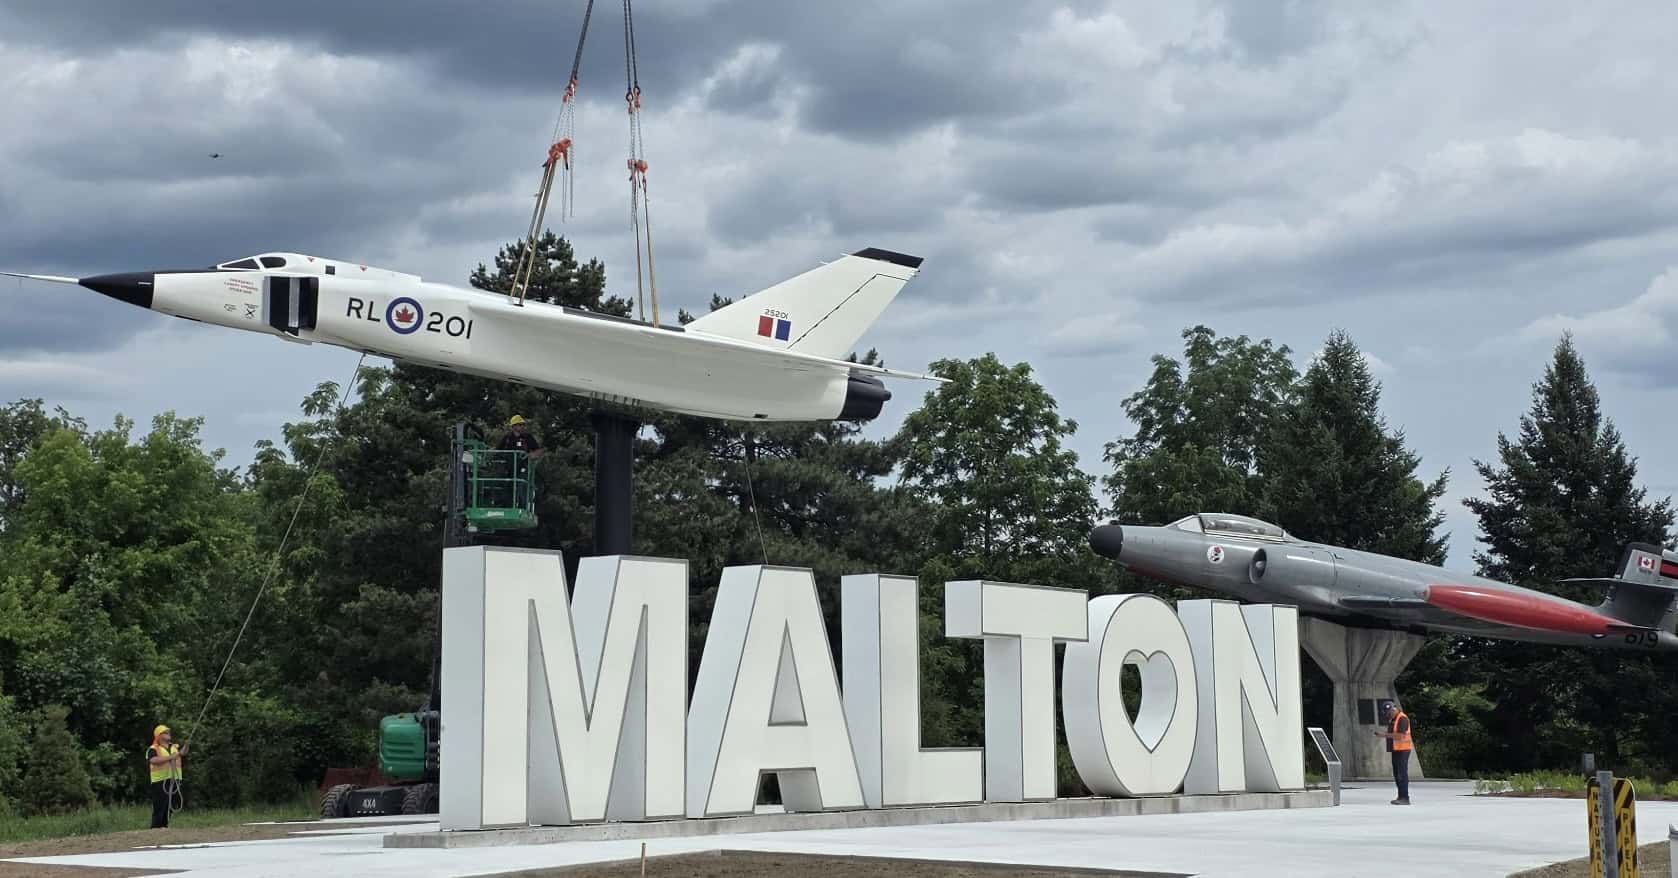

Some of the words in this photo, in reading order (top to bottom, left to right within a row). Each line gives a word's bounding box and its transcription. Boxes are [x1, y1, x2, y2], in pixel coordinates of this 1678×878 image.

[346, 297, 381, 323] RL
[426, 311, 473, 340] 201
[441, 546, 1305, 830] MALTON
